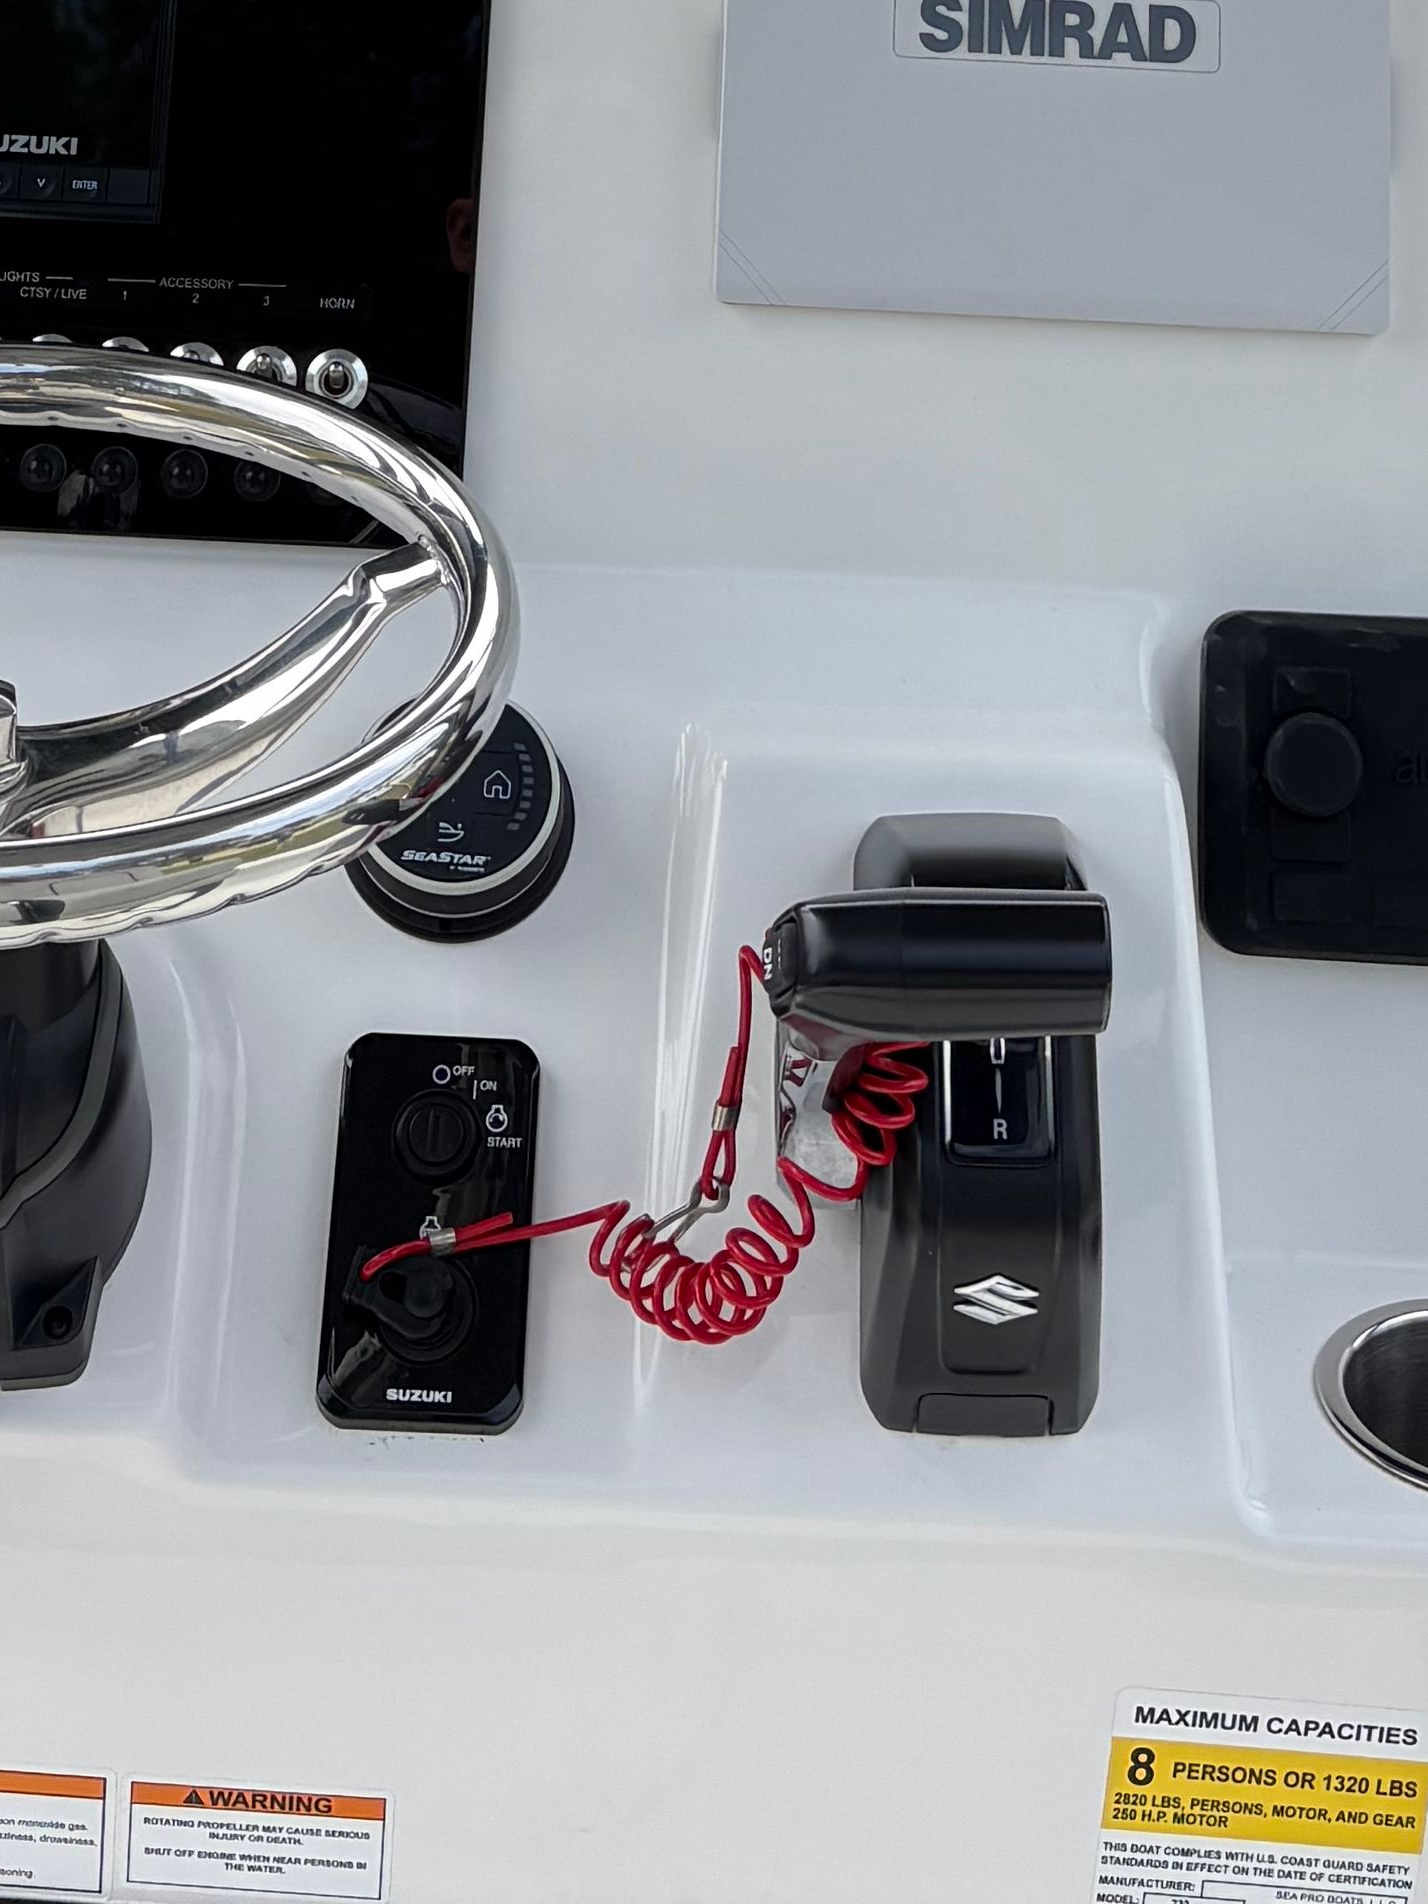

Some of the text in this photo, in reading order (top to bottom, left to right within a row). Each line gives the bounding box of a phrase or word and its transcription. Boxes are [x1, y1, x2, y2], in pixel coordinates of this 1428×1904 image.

[72, 179, 98, 190] ENTER
[160, 277, 234, 290] ACCESSORY
[20, 286, 52, 298] CTSY
[61, 288, 86, 300] LIVE
[122, 290, 126, 301] 1
[192, 293, 200, 304] 2
[263, 296, 270, 306] 3
[320, 298, 355, 310] HORN
[401, 850, 486, 866] SEASTAR
[452, 1066, 475, 1076] OFF
[480, 1080, 498, 1091] ON
[994, 1118, 1008, 1140] R
[486, 1136, 522, 1148] START
[386, 1388, 452, 1404] SUZUKI
[1134, 1706, 1418, 1746] MAXIMUM CAPACITIES
[1128, 1747, 1418, 1798] 8 PERSONS OR 1320 LBS
[208, 1790, 332, 1814] WARNING
[1112, 1808, 1229, 1828] 250 H.P. MOTOR
[1114, 1792, 1416, 1829] 2820 LBS, PERSONS, MOTOR, AND GEAR
[143, 1816, 370, 1839] ROTATING PROPELLER MAY CAUSE SERIOUS
[248, 1834, 264, 1842] OR
[174, 1848, 194, 1857] OFF
[196, 1850, 236, 1860] ENGINE
[238, 1852, 270, 1863] WHEN
[272, 1855, 301, 1865] NEAR
[304, 1857, 353, 1868] PERSONS
[1103, 1842, 1410, 1876] THIS BOAT COMPLIES WITH U.S. COAST GUARD SAFETY
[224, 1862, 244, 1871] THE
[1100, 1856, 1413, 1889] STANDARDS IN EFFECT ON THE DATE OF CERTIFICATION
[1098, 1875, 1195, 1892] MANUFACTURER:
[1096, 1893, 1139, 1904] MODEL:
